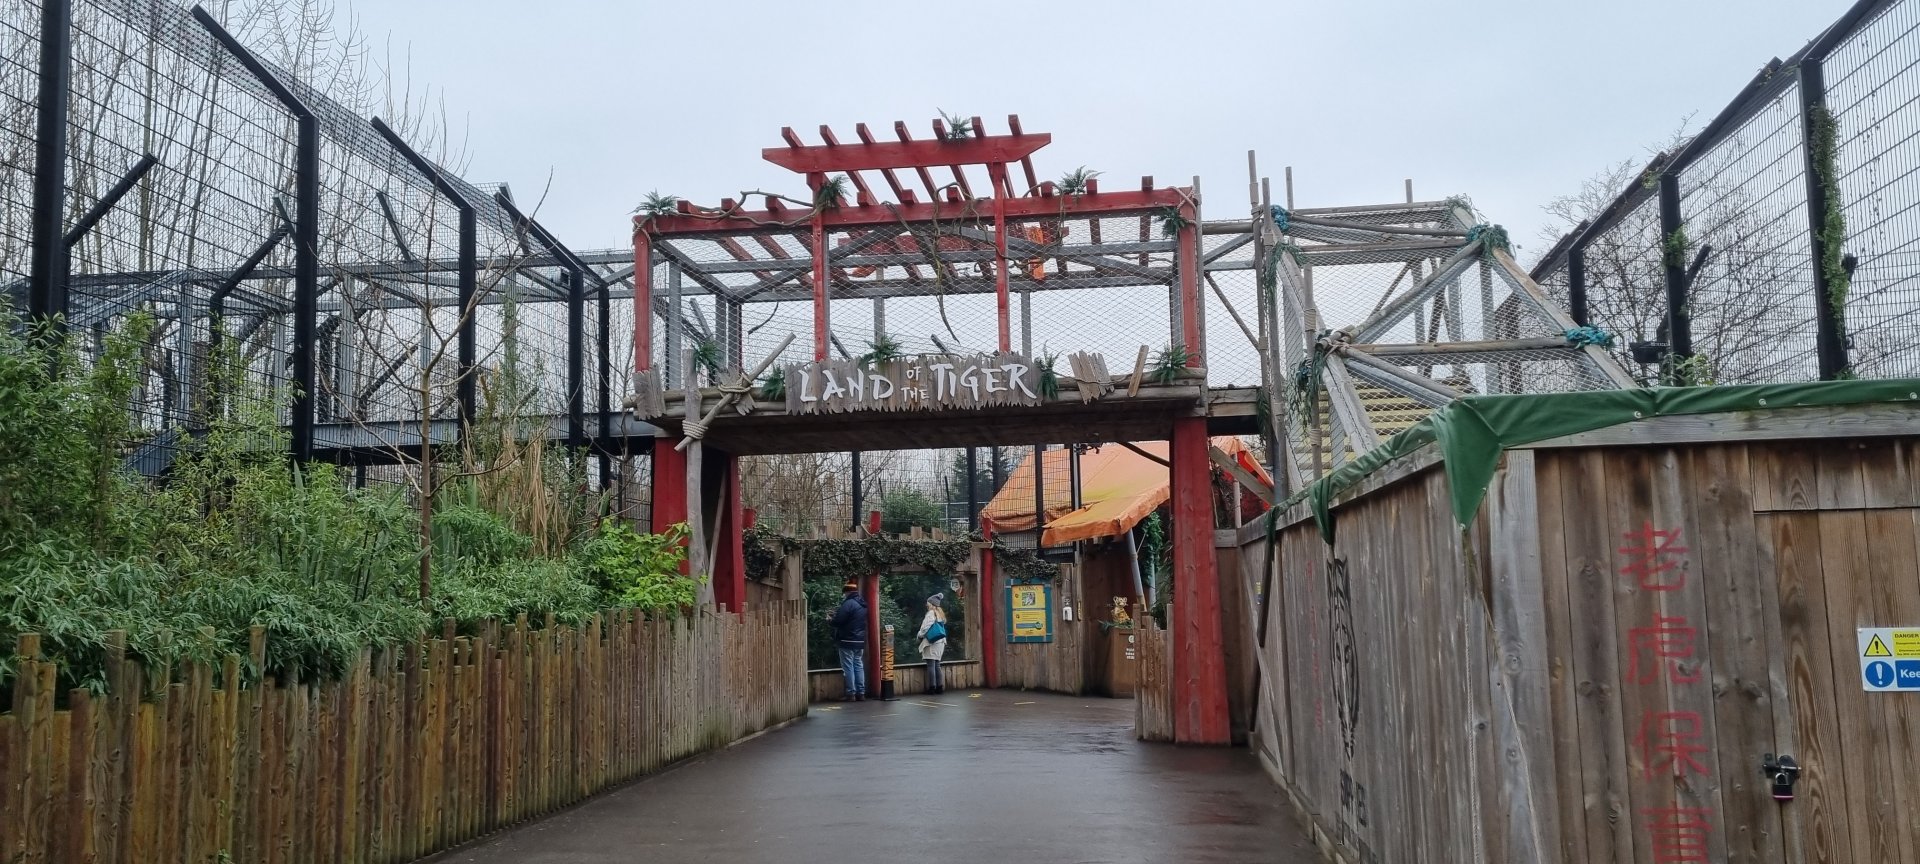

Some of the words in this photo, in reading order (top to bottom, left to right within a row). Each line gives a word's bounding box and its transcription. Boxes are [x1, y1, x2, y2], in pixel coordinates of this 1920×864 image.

[798, 369, 894, 402] LAND
[906, 366, 922, 381] OF
[929, 363, 1038, 402] TIGER
[900, 387, 930, 403] THE
